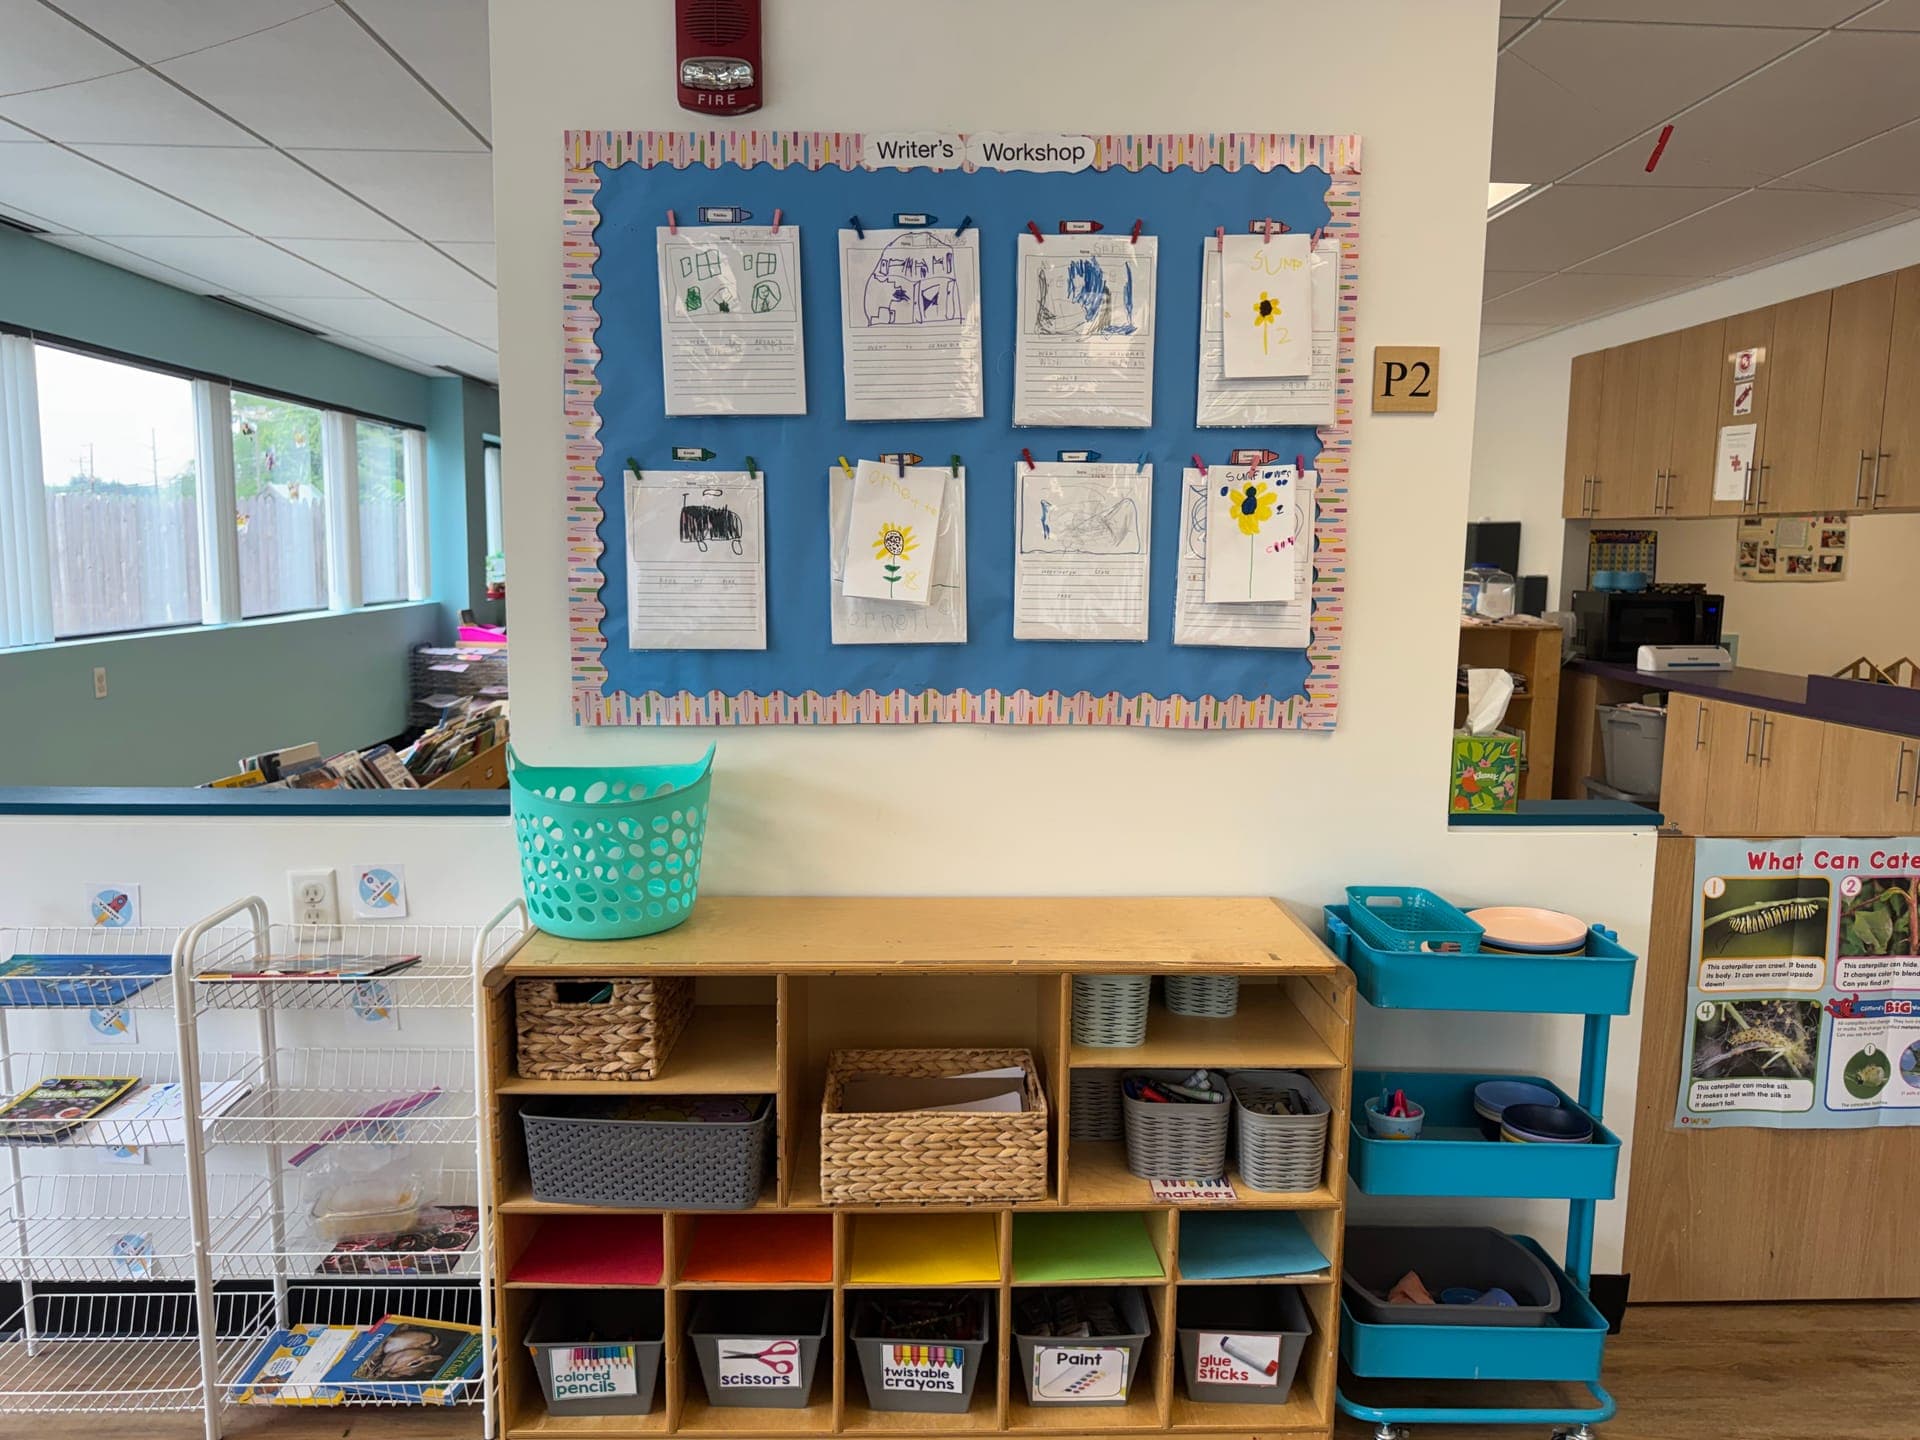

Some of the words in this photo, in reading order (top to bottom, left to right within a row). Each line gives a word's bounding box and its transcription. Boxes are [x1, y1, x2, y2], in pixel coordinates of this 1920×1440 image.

[697, 94, 736, 105] FIRE
[877, 139, 954, 159] Writer's
[982, 142, 1085, 164] Workshop
[1380, 361, 1431, 397] P2
[1748, 851, 1804, 870] What
[1814, 851, 1860, 869] Can
[1869, 851, 1920, 869] Cate
[1711, 881, 1717, 894] 1
[1846, 880, 1856, 893] 2
[1850, 971, 1877, 979] changes
[1701, 1004, 1711, 1019] 4
[1156, 1190, 1233, 1199] markers
[1056, 1352, 1103, 1366] Paint
[1200, 1354, 1232, 1368] glue
[555, 1366, 611, 1383] colored
[721, 1373, 791, 1386] scissors
[884, 1367, 950, 1379] twistable
[1200, 1367, 1249, 1381] sticks
[556, 1380, 616, 1398] pencils
[885, 1378, 955, 1392] crayons
